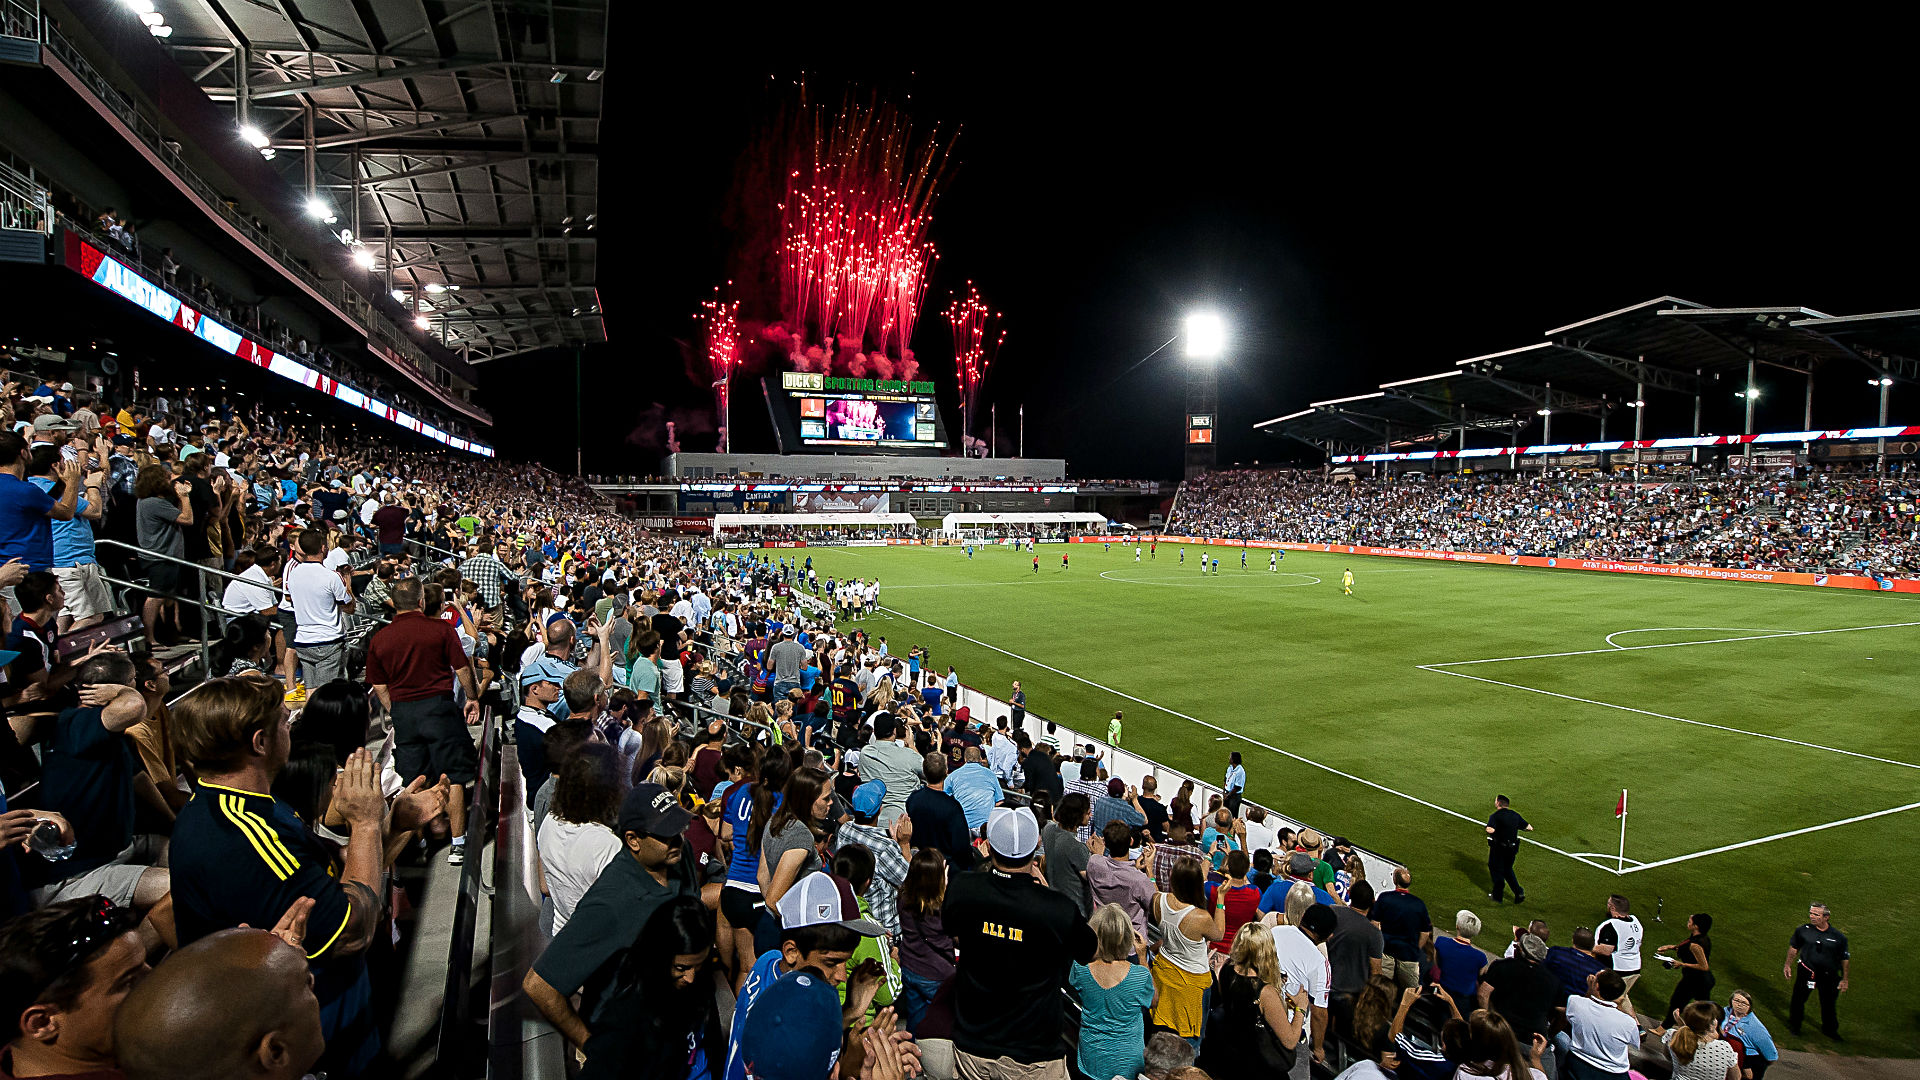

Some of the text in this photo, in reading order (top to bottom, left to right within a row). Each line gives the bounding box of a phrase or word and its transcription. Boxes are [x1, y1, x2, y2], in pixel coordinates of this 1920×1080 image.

[103, 258, 173, 323] ALL-STARS
[181, 302, 196, 332] VS
[785, 374, 936, 394] DICK'S SPORTING GOODS PARK
[1643, 454, 1687, 462] FAVORITES
[746, 492, 772, 500] CANTINA
[667, 518, 673, 528] IS
[1639, 565, 1668, 574] Partner
[1680, 568, 1704, 577] Major
[1706, 569, 1738, 579] League
[1740, 571, 1773, 580] Soccer
[832, 689, 844, 706] 10
[952, 746, 962, 761] 9
[738, 798, 754, 822] U
[983, 922, 1023, 941] ALL IN
[1630, 924, 1639, 932] 18
